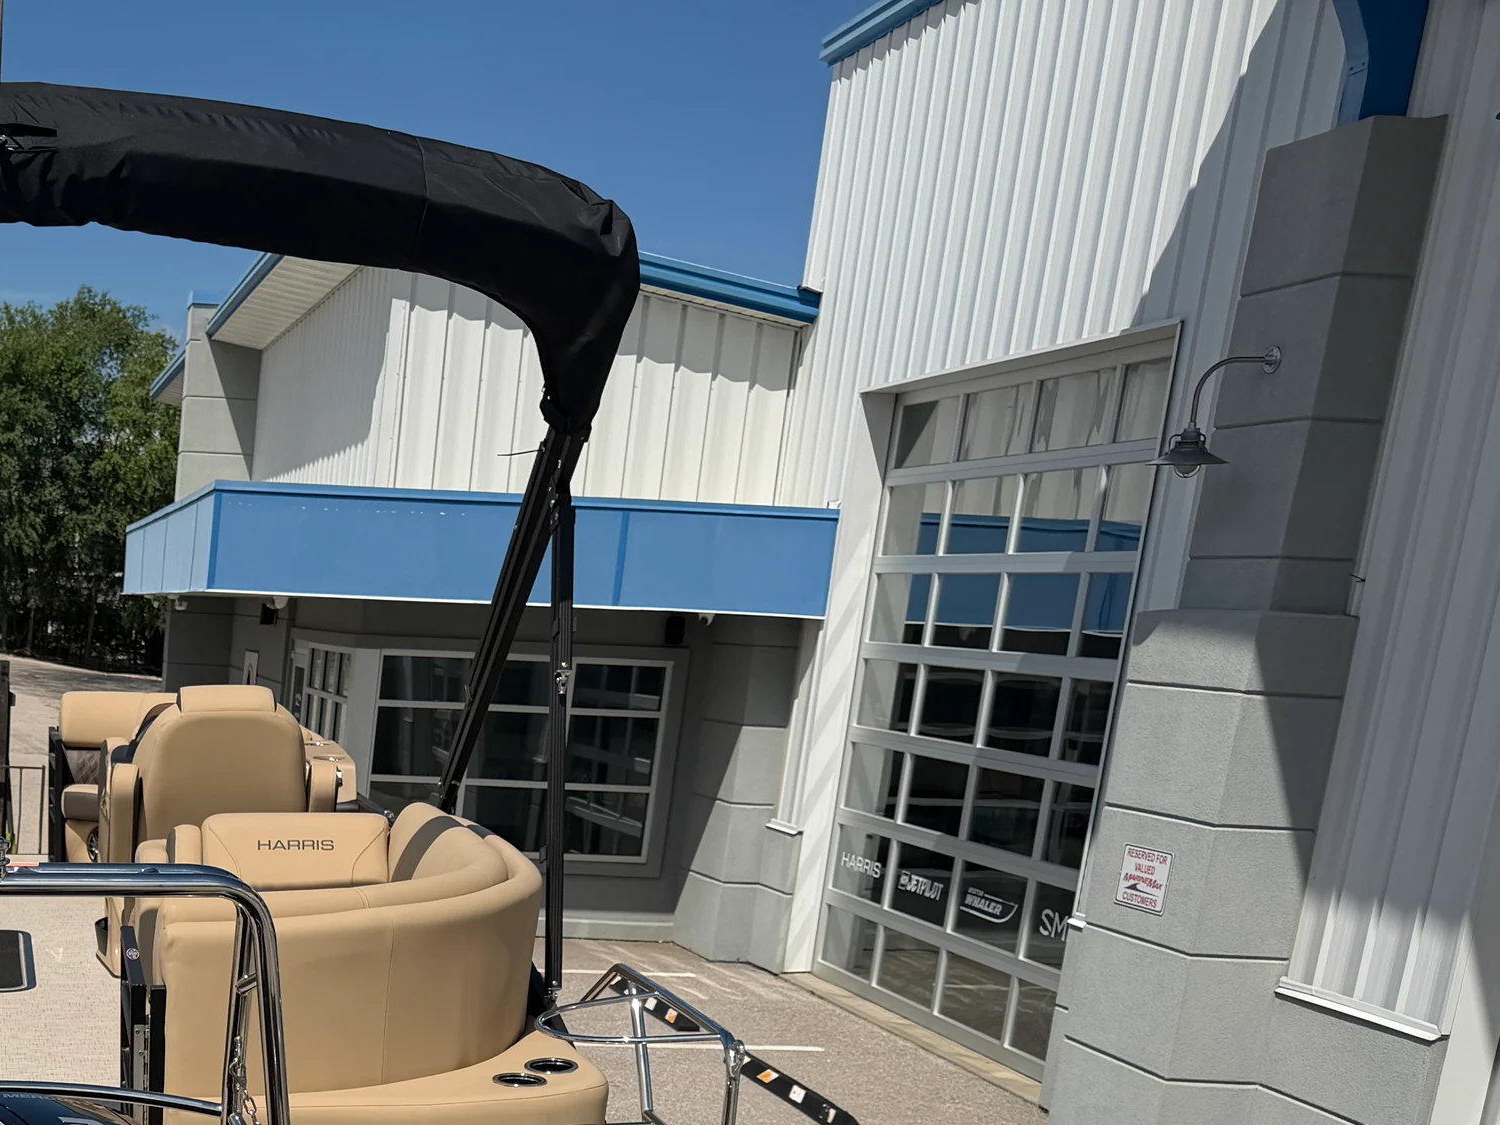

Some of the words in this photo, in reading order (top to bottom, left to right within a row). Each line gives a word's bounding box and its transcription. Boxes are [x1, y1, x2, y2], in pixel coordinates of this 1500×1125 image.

[257, 839, 335, 851] HARRIS
[1127, 848, 1156, 862] RESERVED
[1155, 854, 1168, 865] FOR
[841, 852, 882, 879] HARRIS
[1135, 862, 1156, 875] VALUED
[964, 893, 1003, 916] WHALER
[1122, 891, 1158, 909] CUSTOMERS
